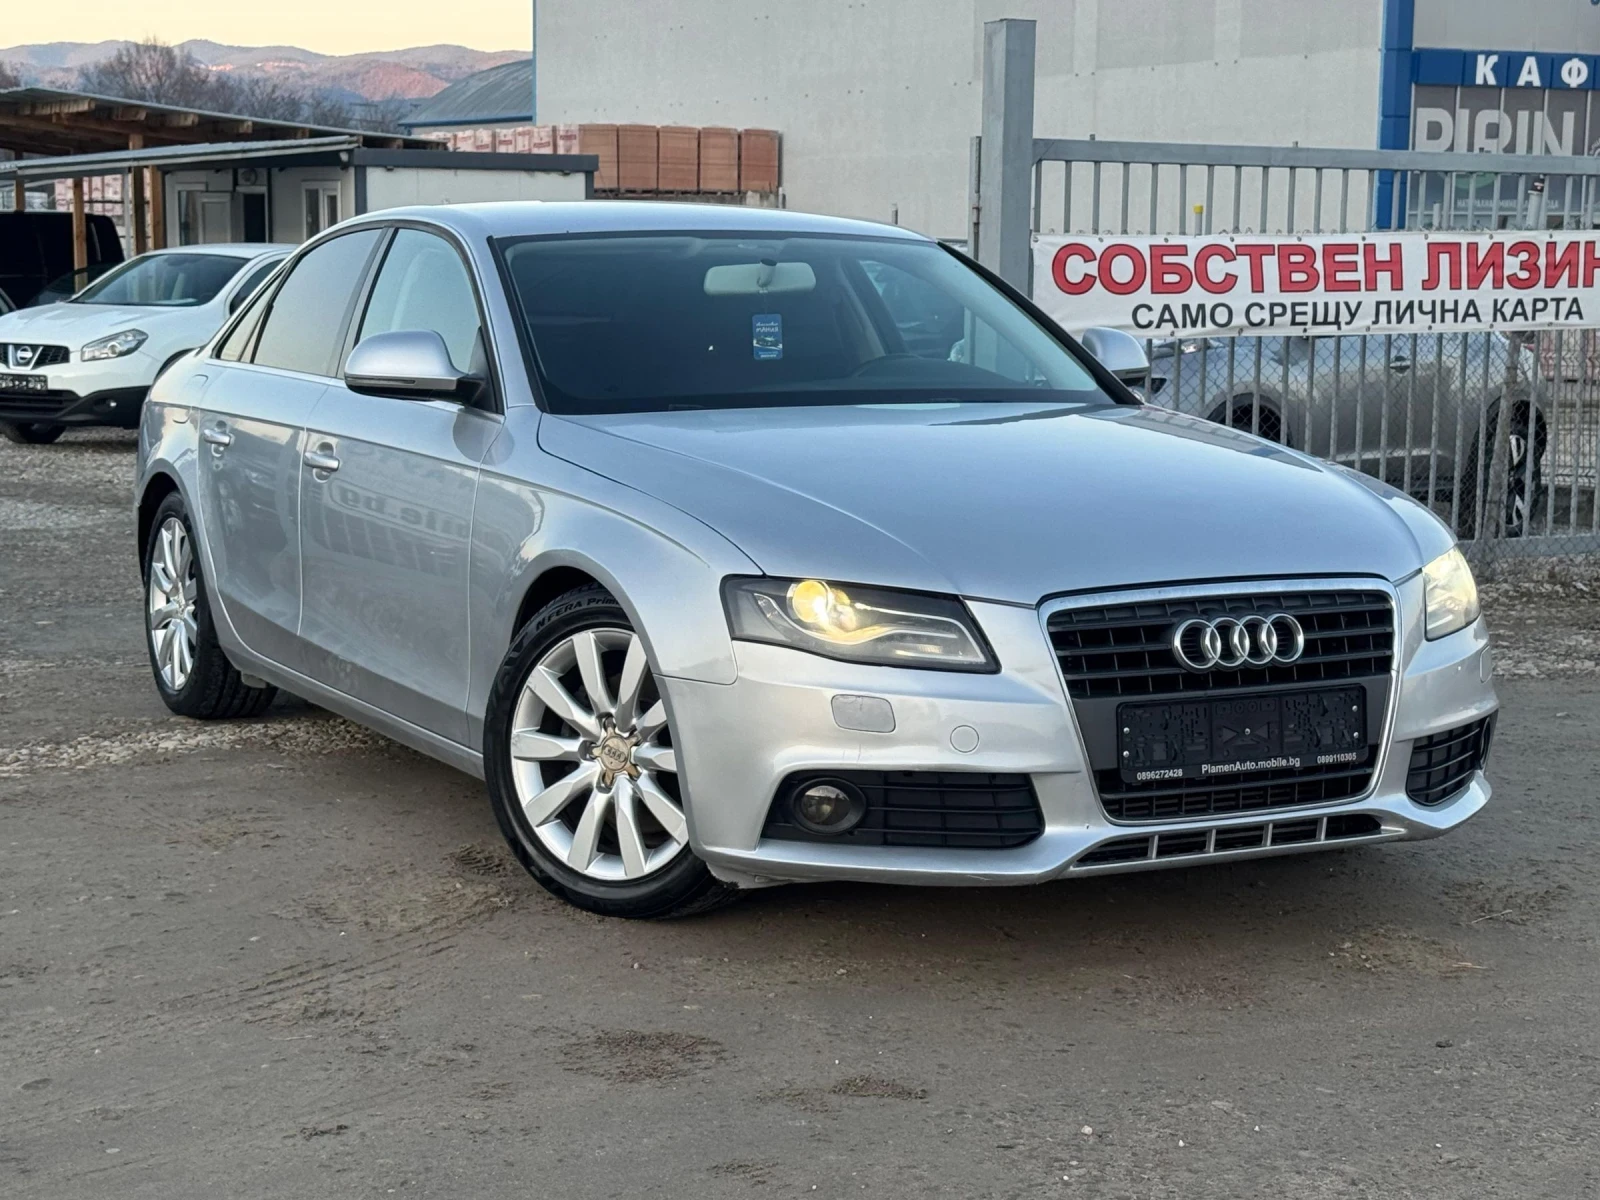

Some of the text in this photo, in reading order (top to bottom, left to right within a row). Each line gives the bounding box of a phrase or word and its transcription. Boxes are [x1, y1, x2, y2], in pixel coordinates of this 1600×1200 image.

[1475, 54, 1589, 88] КАФ
[1051, 242, 1404, 296] СОБСТВЕН
[1131, 296, 1584, 331] САМО СРЕЩУ ЛИЧНА КАРТА
[1201, 756, 1301, 775] PlamenAuto.mobile.bg
